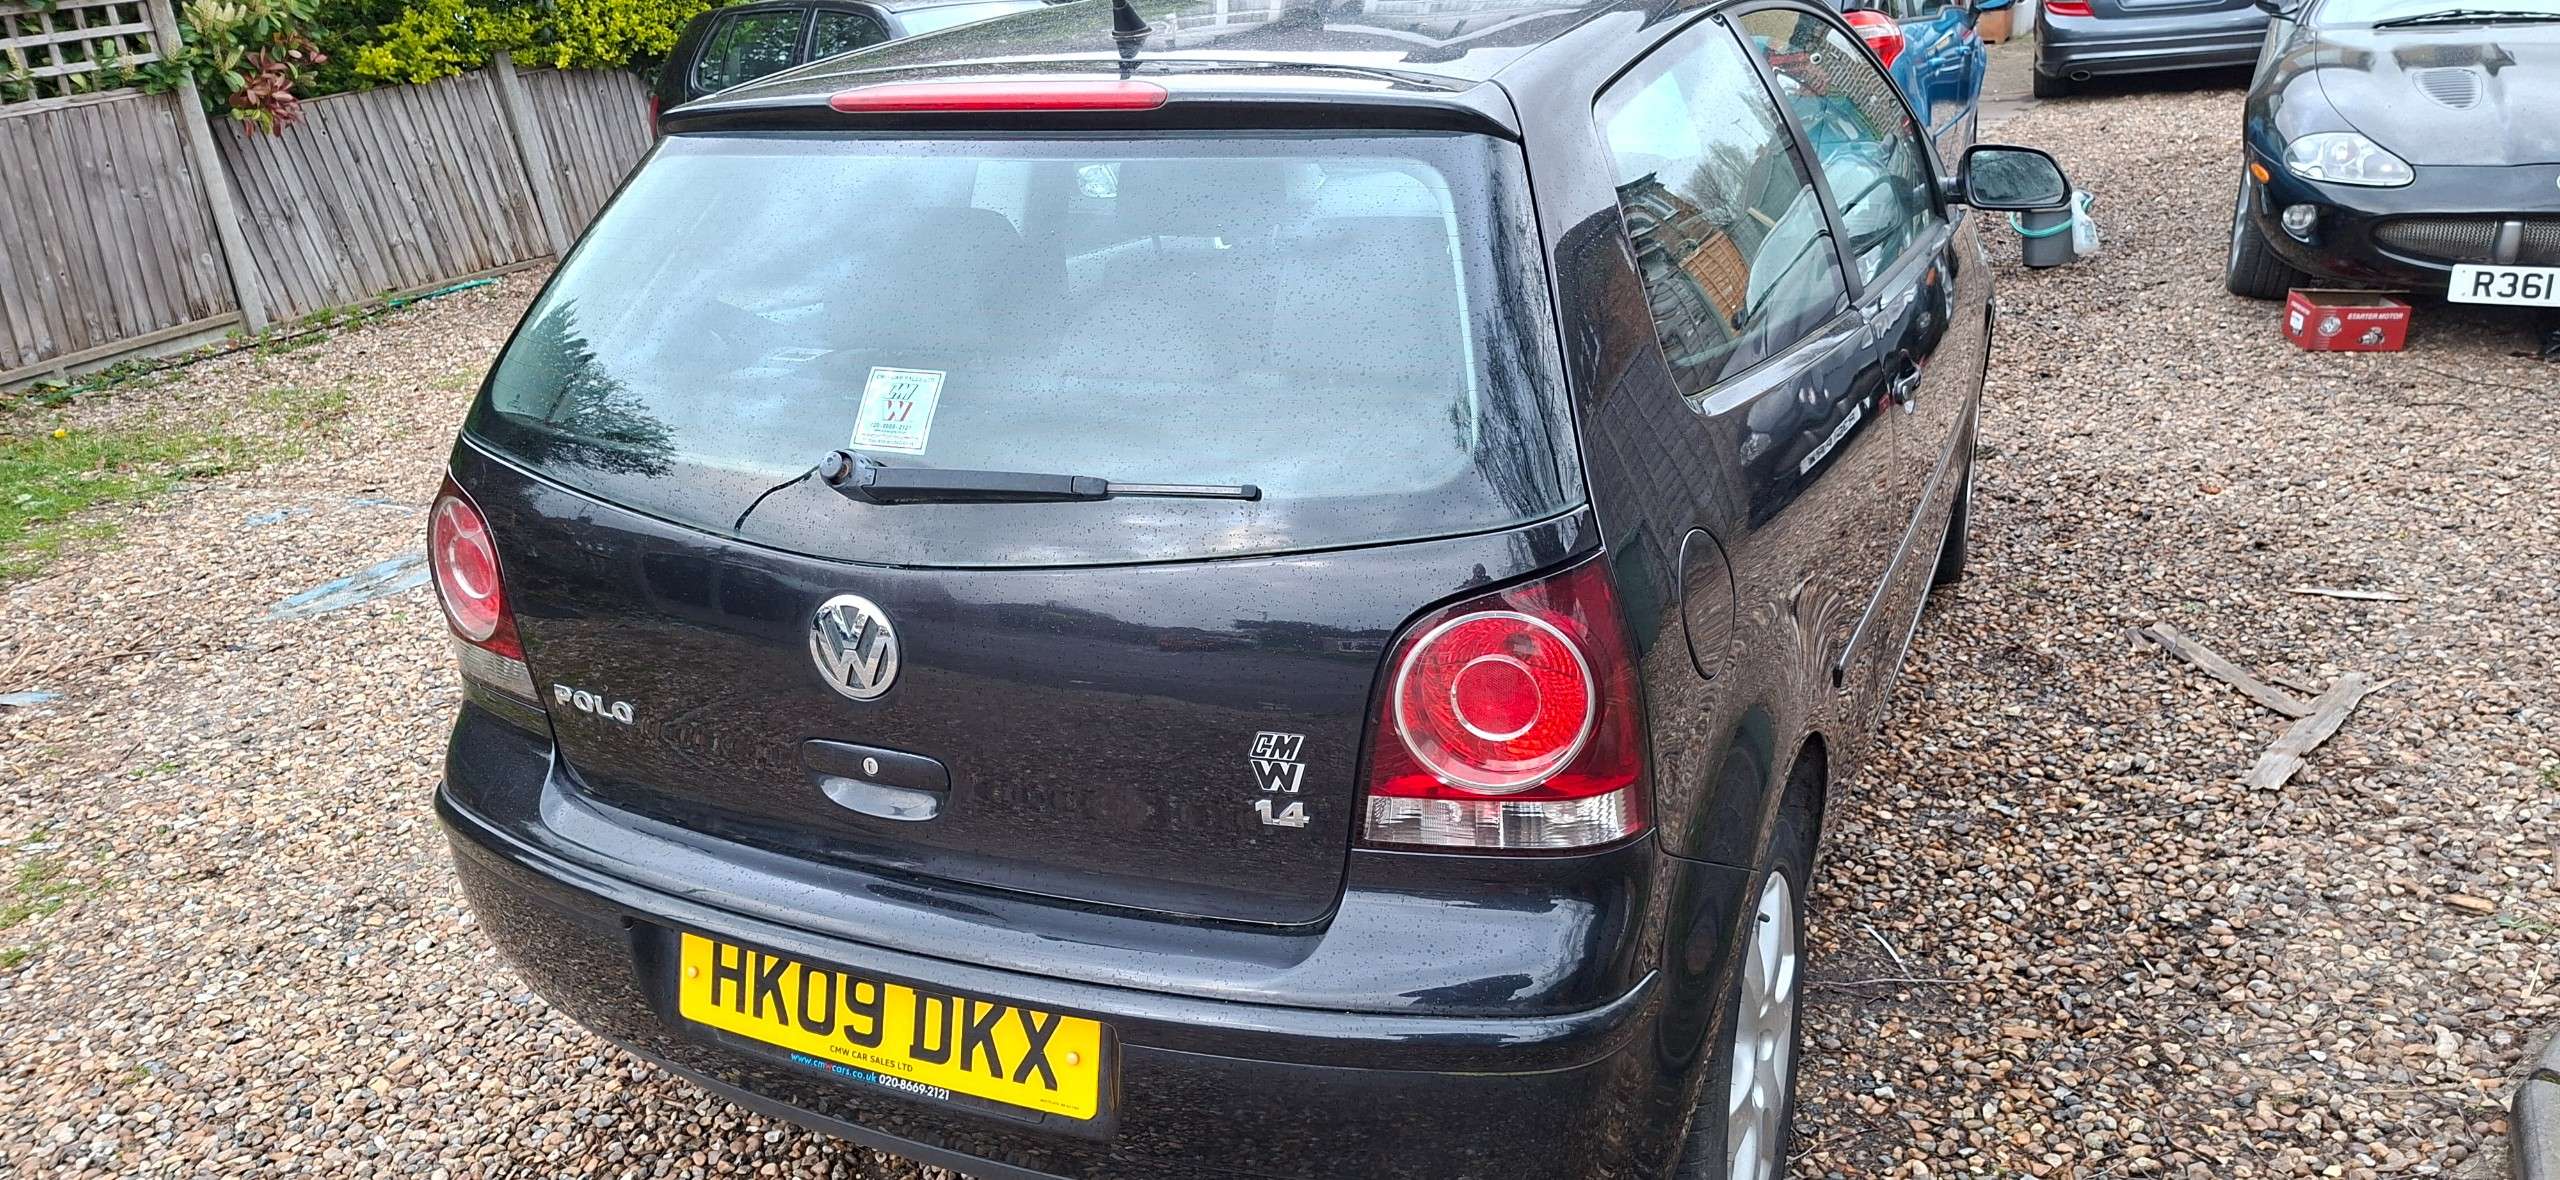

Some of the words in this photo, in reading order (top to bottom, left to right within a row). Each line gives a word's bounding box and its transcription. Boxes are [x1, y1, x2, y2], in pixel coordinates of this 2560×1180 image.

[2472, 271, 2555, 300] R361
[554, 683, 634, 726] POLO
[711, 942, 885, 1048] HK09
[909, 989, 1062, 1092] DKX
[790, 1053, 877, 1083] www.cmwcars.co.uk
[878, 1074, 950, 1100] 020-8669-2121
[829, 1045, 850, 1056] CMW
[852, 1049, 868, 1061] CAR
[870, 1055, 895, 1068] SALES
[897, 1062, 913, 1072] LTD
